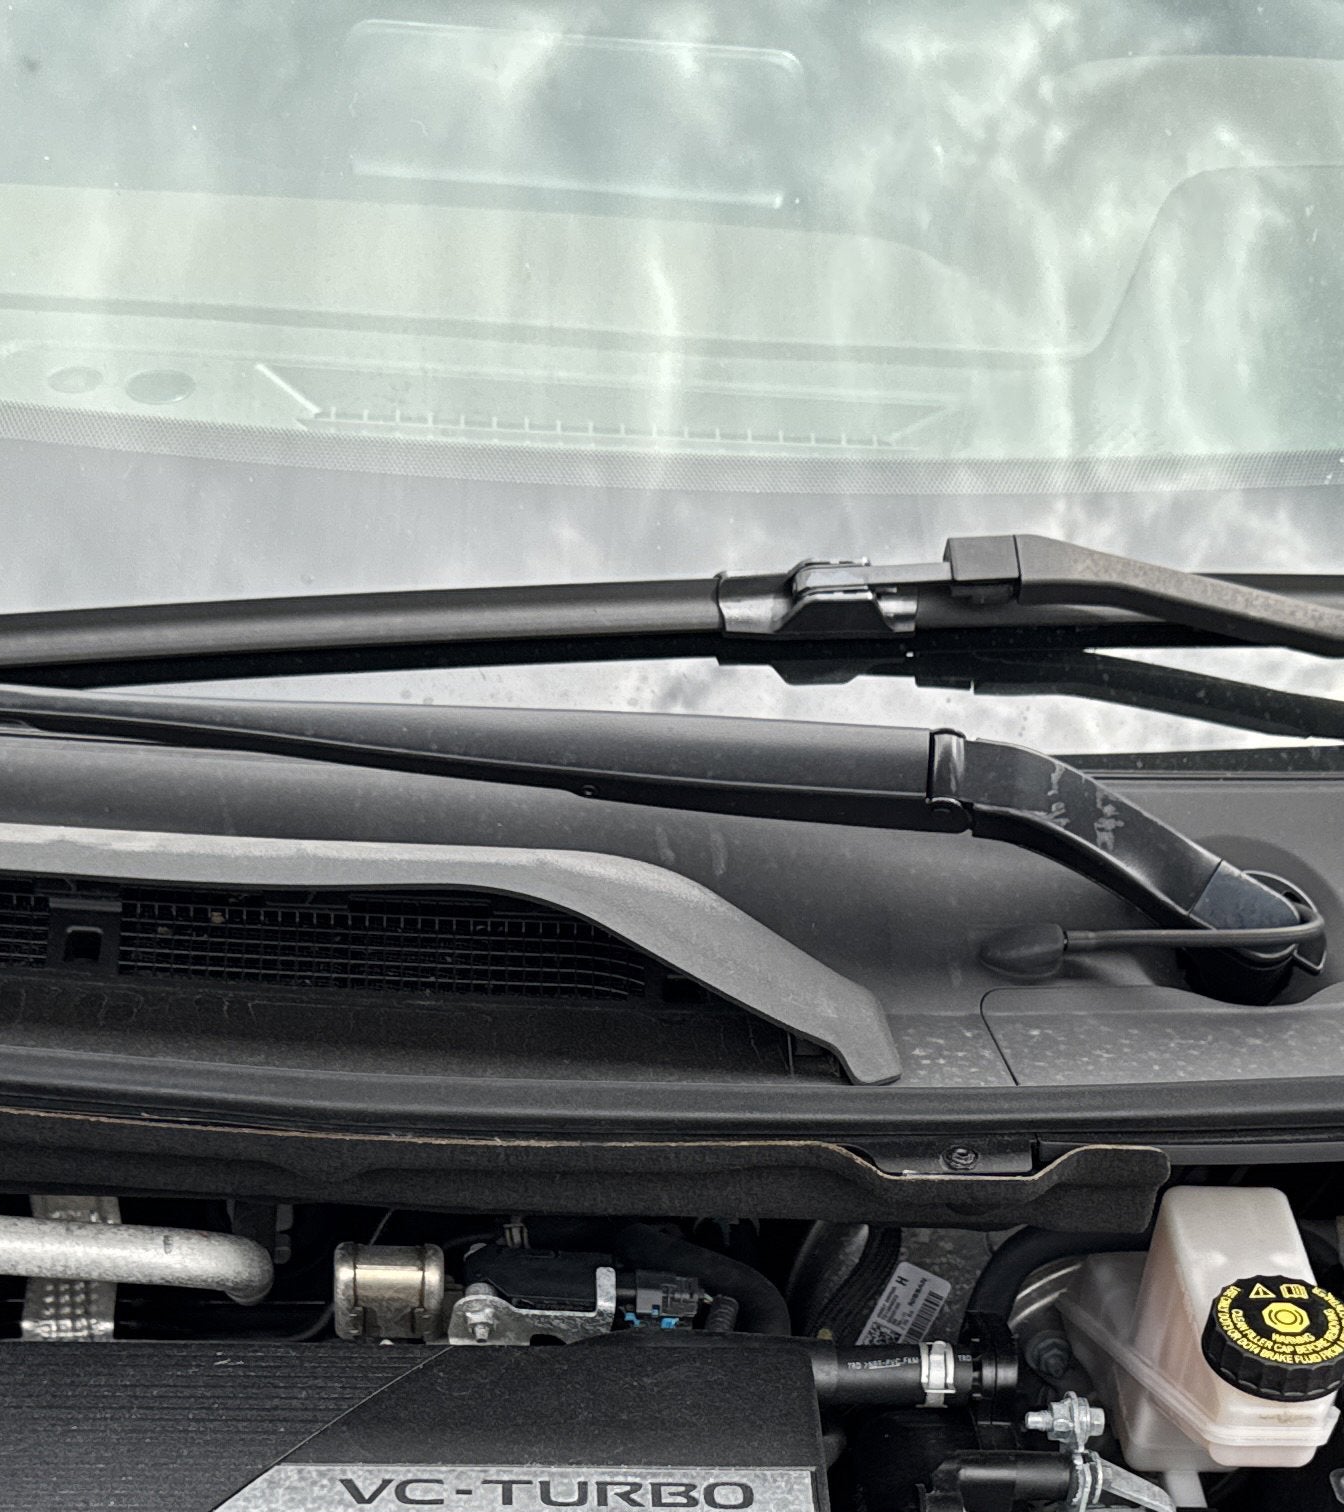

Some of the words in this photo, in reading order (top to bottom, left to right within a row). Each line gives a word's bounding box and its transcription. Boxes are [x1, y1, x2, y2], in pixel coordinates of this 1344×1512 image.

[1260, 1347, 1294, 1364] BRAKE
[1273, 1344, 1296, 1355] CAP
[338, 1478, 755, 1510] VC-TURBO
